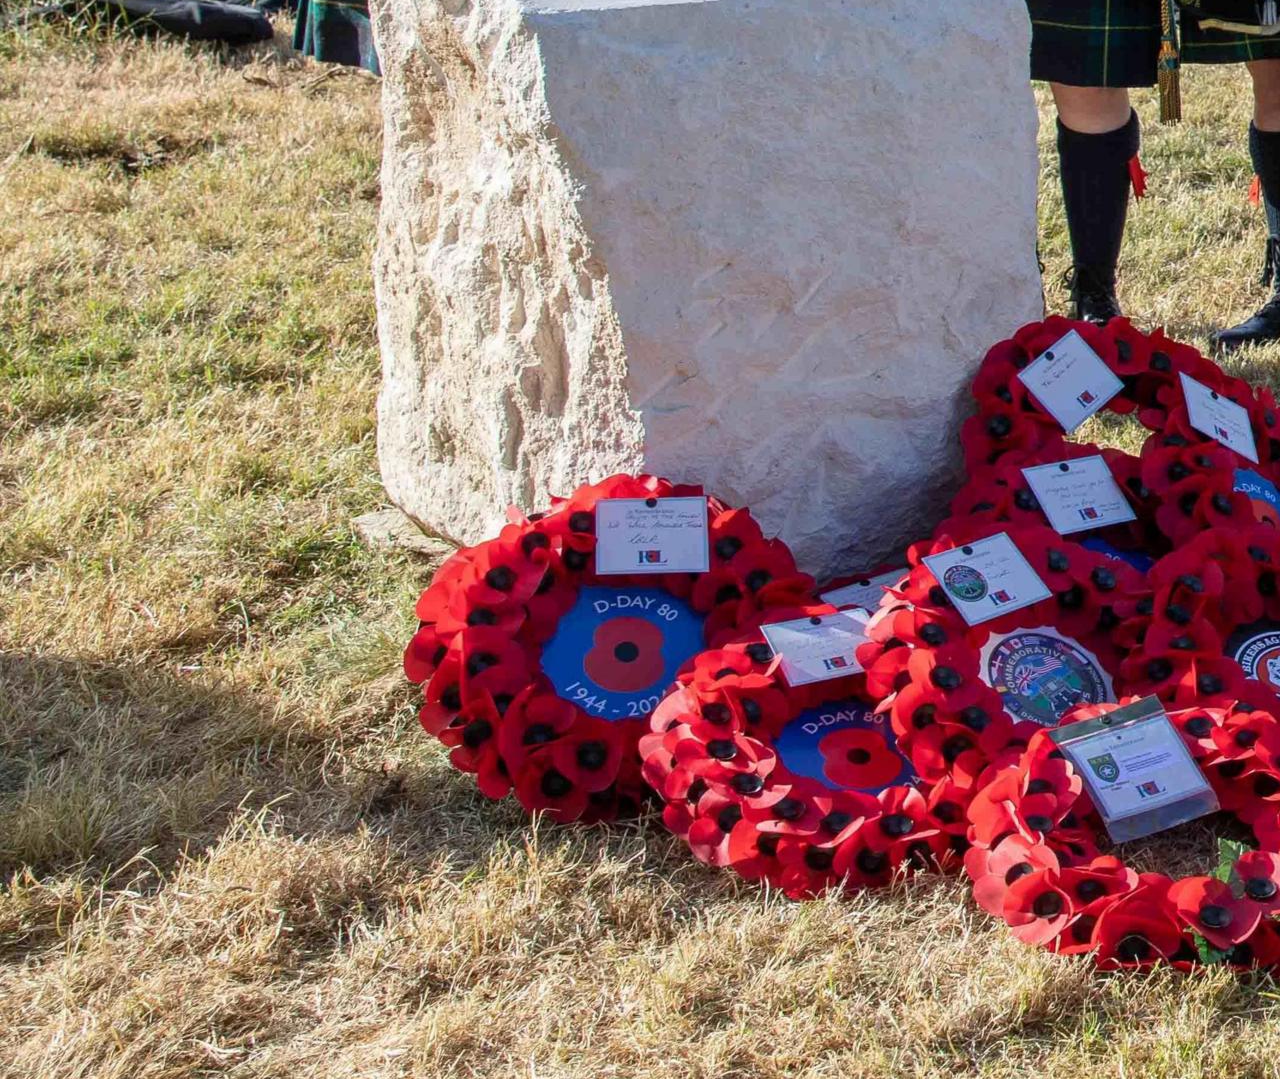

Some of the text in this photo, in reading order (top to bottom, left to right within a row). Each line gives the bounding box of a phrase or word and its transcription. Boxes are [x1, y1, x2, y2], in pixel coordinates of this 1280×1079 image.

[594, 595, 678, 621] D-DAY 80
[1005, 647, 1067, 694] COMMEMORATIVE
[1242, 640, 1266, 672] BIKERS
[565, 681, 608, 713] 1944
[627, 689, 667, 716] 202
[802, 710, 885, 735] D-DAY 80
